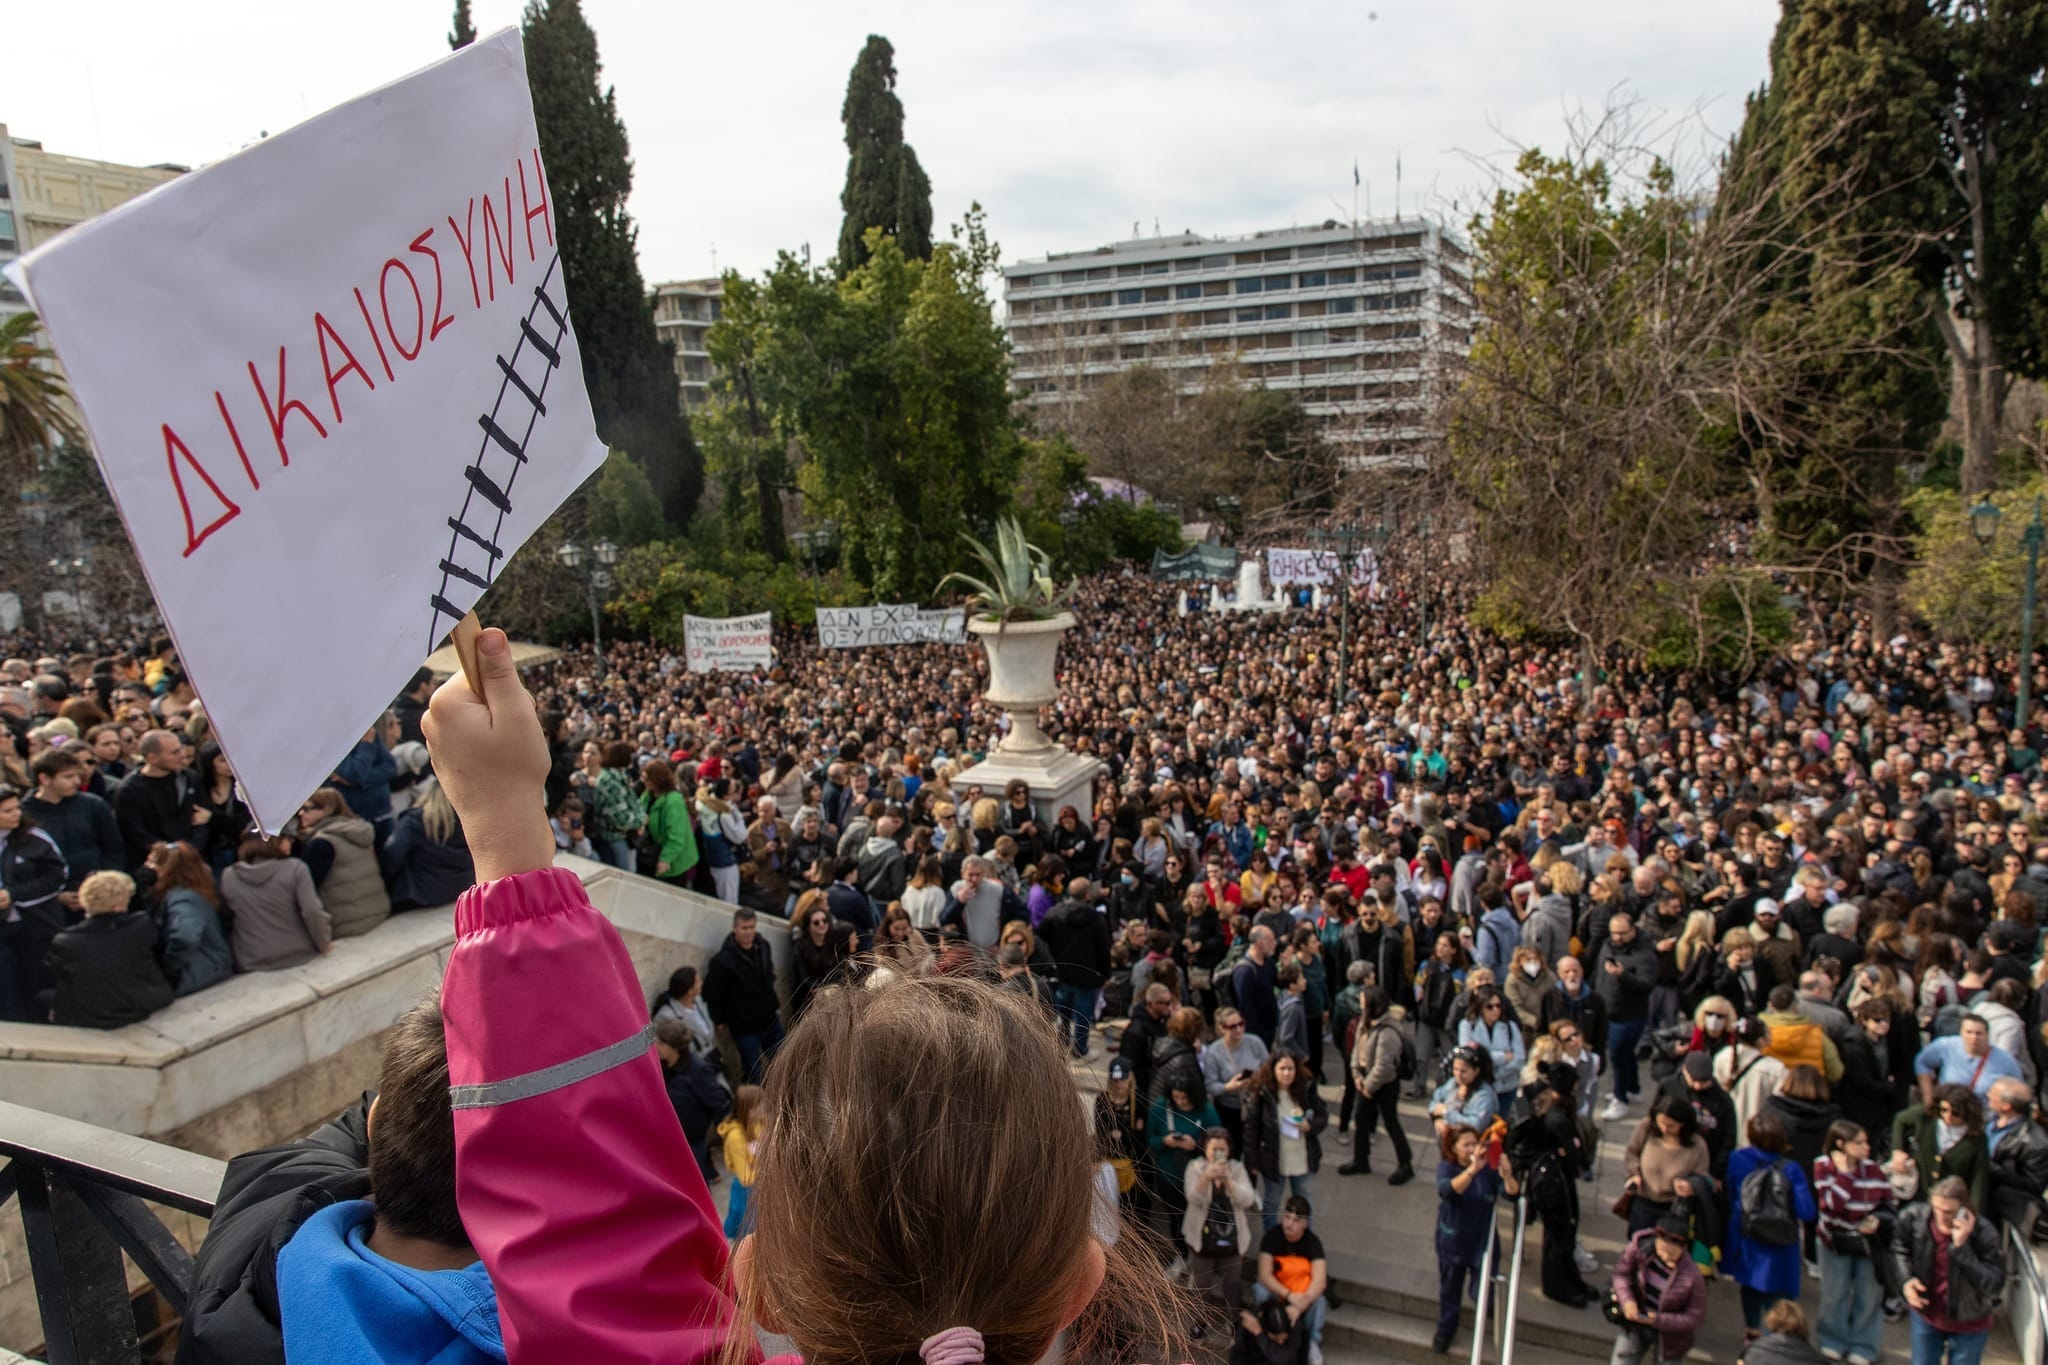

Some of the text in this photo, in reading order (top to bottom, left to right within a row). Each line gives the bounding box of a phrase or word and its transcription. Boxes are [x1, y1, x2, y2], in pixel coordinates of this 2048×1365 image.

[162, 148, 553, 559] ΔΙΚΑΙΟΣΥΝΗ
[821, 610, 861, 628] ΔΕΝ
[871, 604, 917, 626] ΕΧΩ
[822, 625, 916, 648] ΟΞΥΓΟΝΟ
